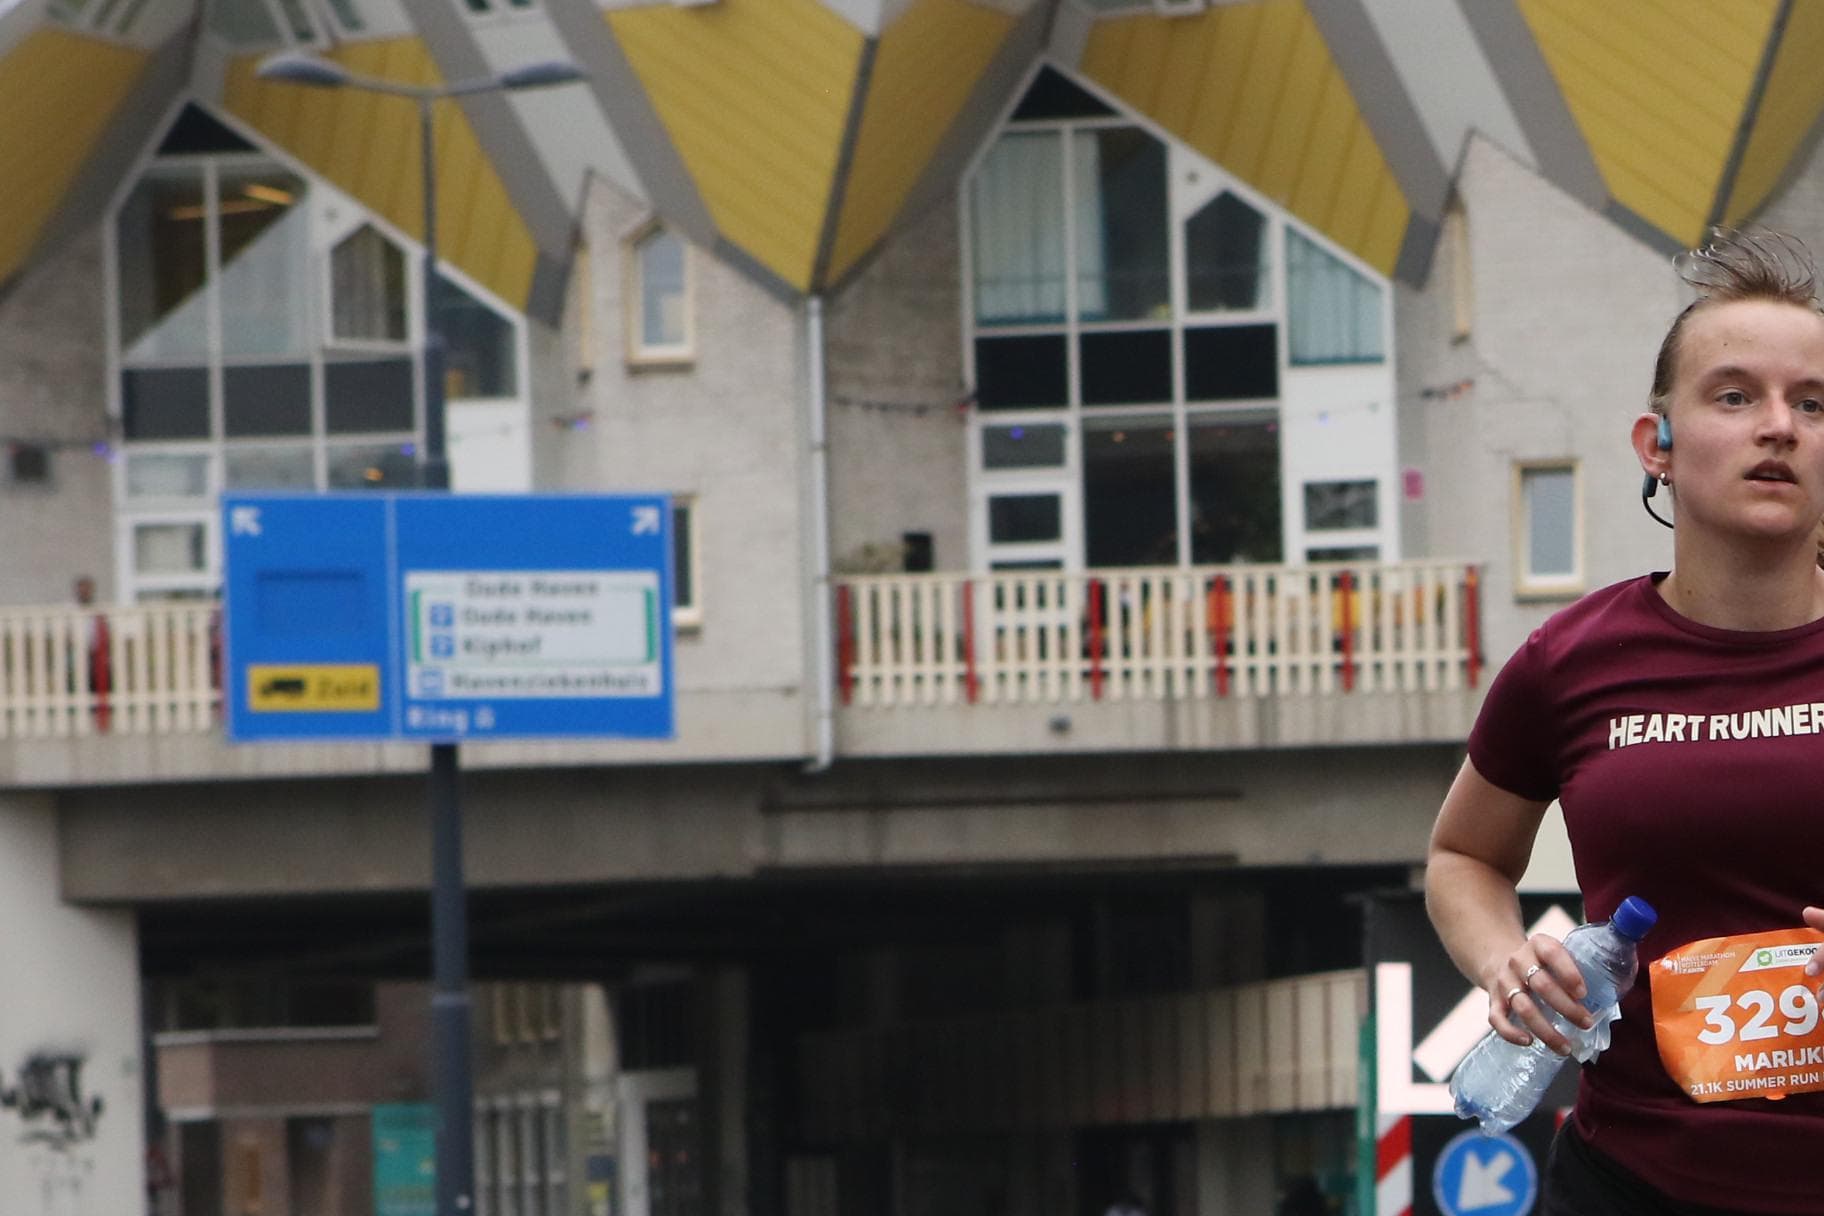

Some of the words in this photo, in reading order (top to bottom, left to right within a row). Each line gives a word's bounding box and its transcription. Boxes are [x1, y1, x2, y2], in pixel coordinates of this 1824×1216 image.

[1608, 714, 1706, 750] HEART
[1691, 1082, 1722, 1096] 21.1K
[1726, 1076, 1786, 1092] SUMMER
[1790, 1073, 1819, 1085] RUN
